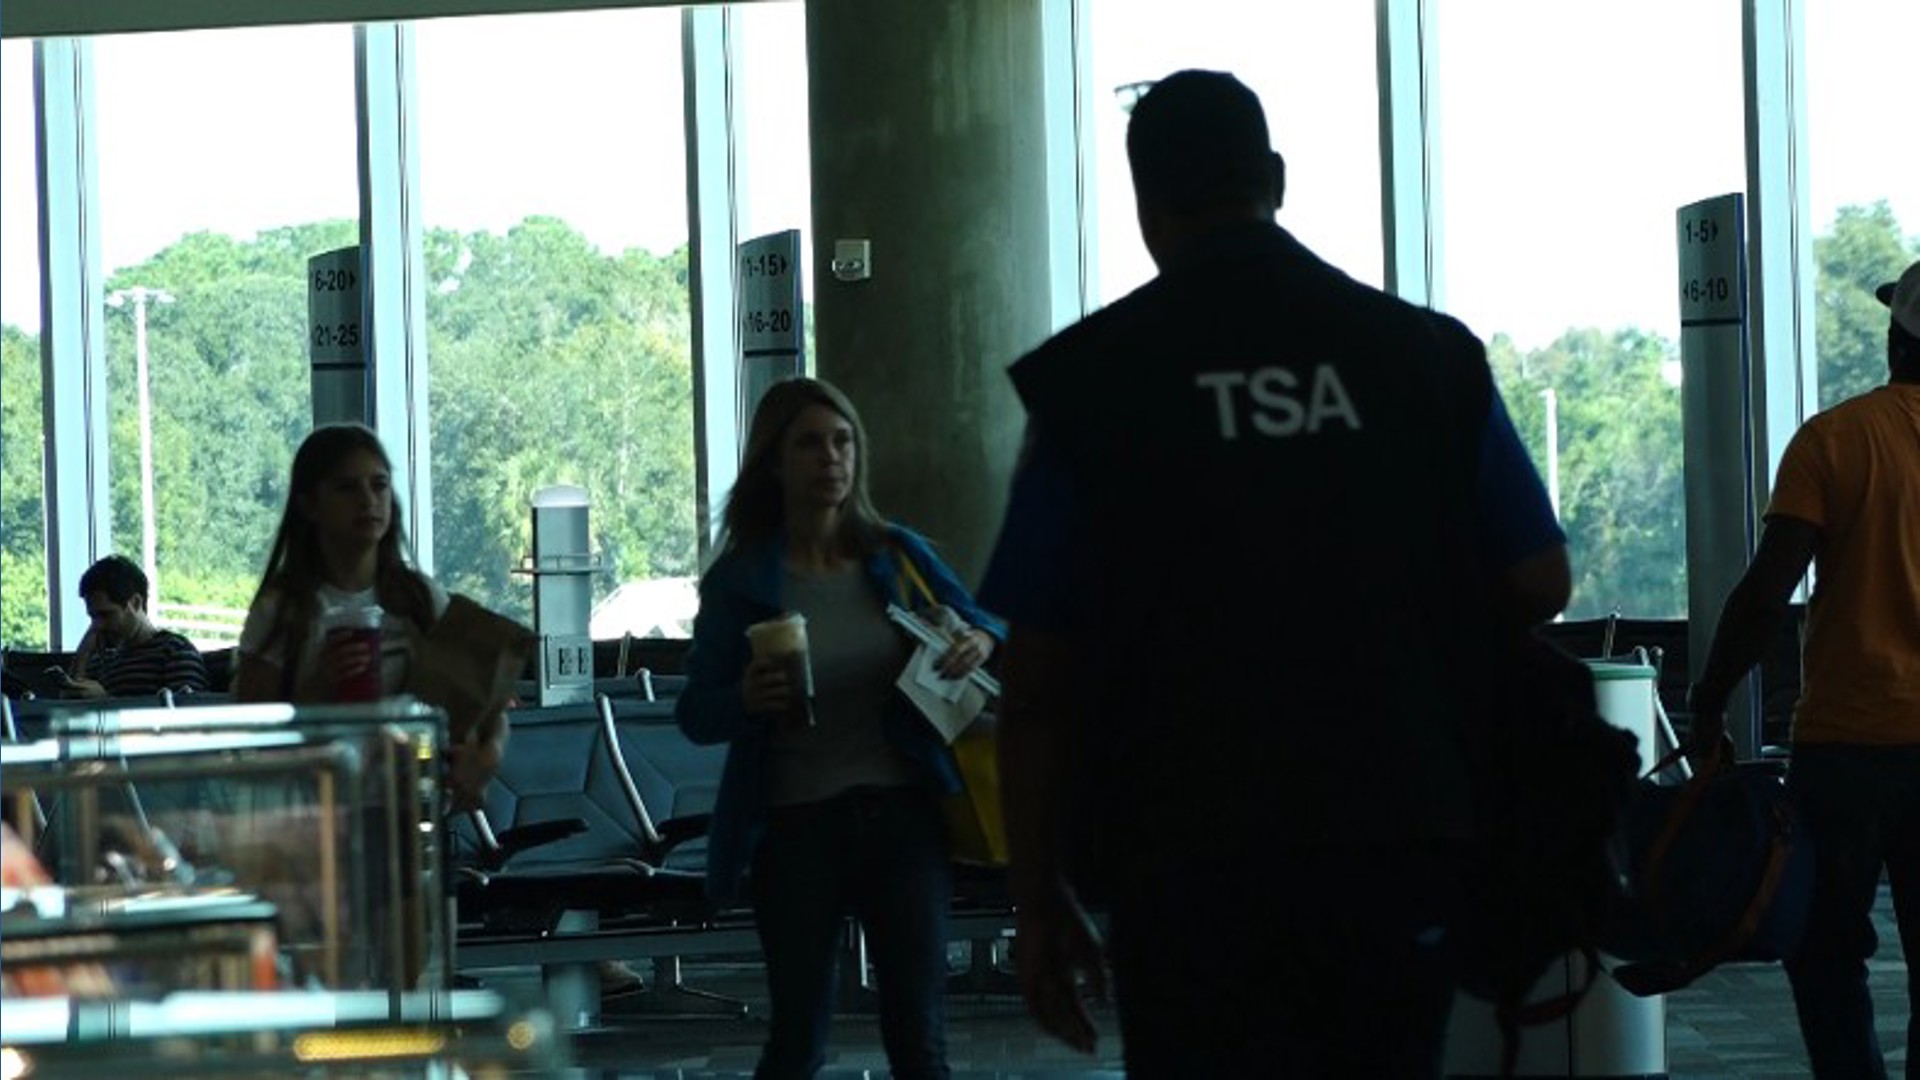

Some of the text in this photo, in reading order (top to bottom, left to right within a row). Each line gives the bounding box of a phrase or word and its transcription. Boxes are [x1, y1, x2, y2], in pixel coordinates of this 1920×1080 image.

[1686, 219, 1709, 244] 1-5
[1690, 277, 1728, 302] 6-10
[748, 309, 791, 333] 16-20
[315, 324, 359, 347] 21-25
[1195, 363, 1362, 440] TSA
